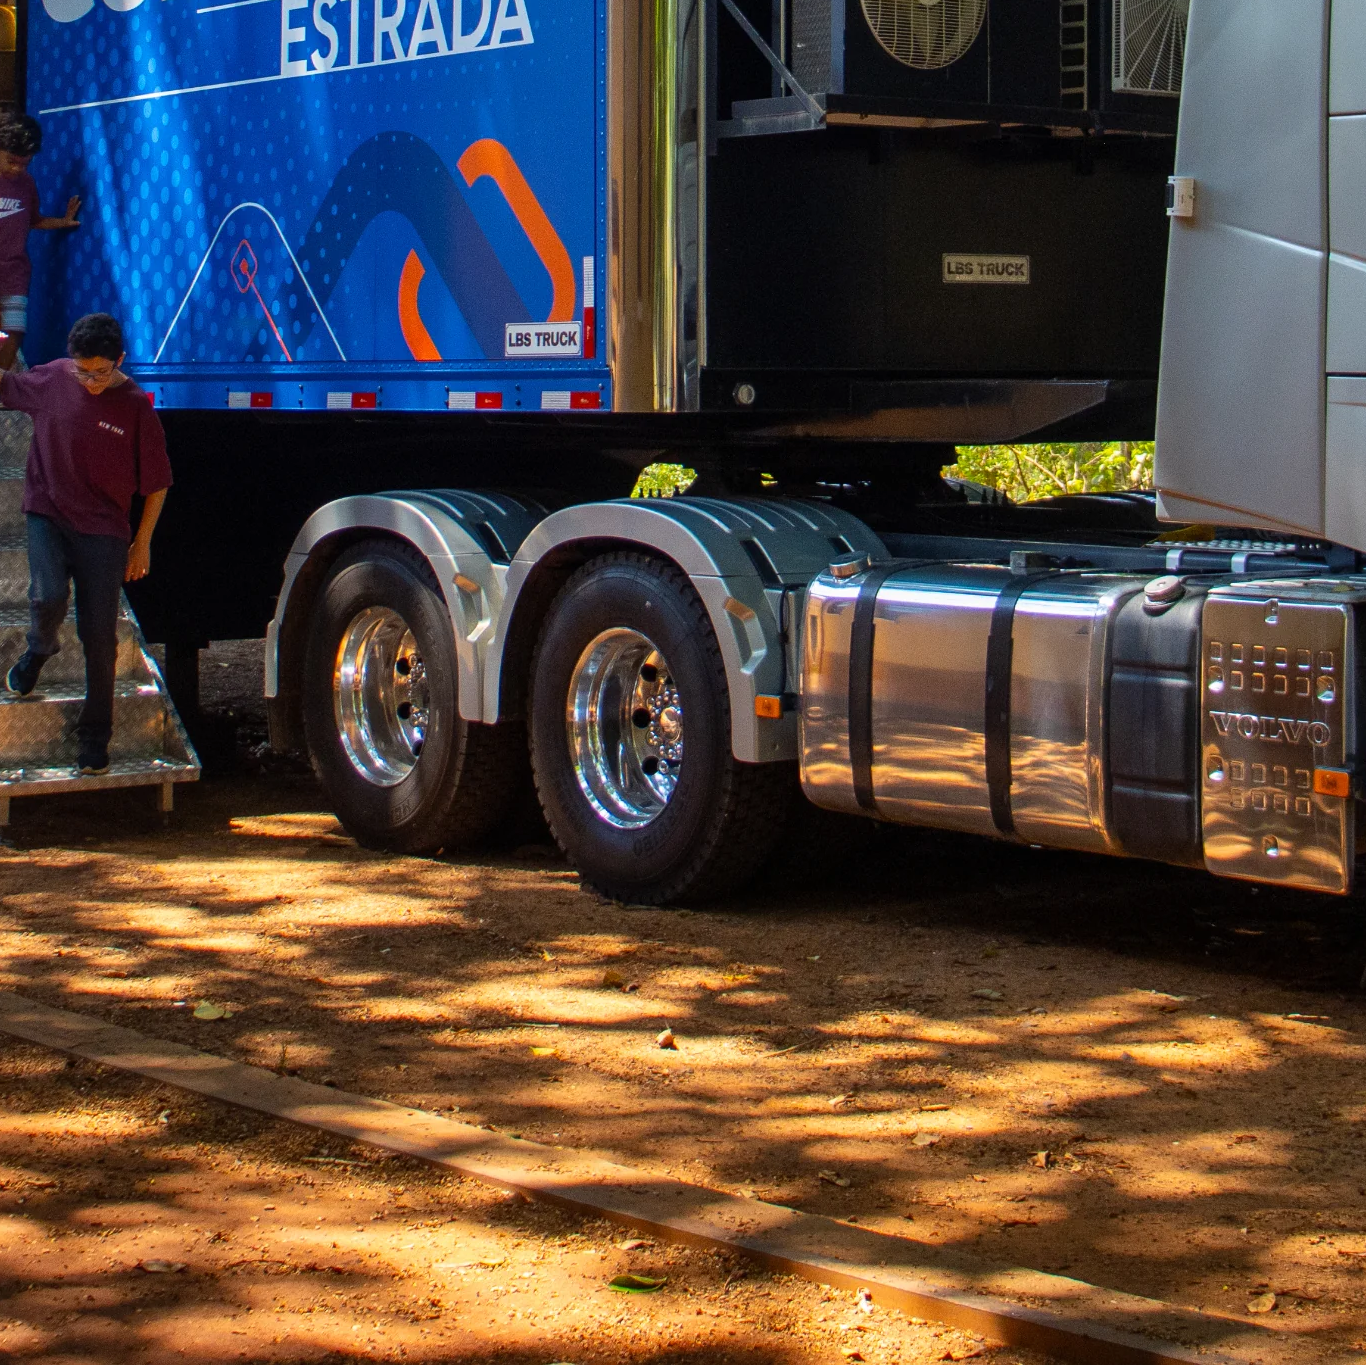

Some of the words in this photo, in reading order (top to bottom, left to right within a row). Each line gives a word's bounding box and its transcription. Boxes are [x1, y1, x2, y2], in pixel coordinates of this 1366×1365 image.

[946, 261, 973, 275] LBS
[976, 262, 1025, 276] TRUCK
[508, 332, 532, 347] LBS
[534, 331, 578, 347] TRUCK
[1209, 710, 1331, 747] VOLVO
